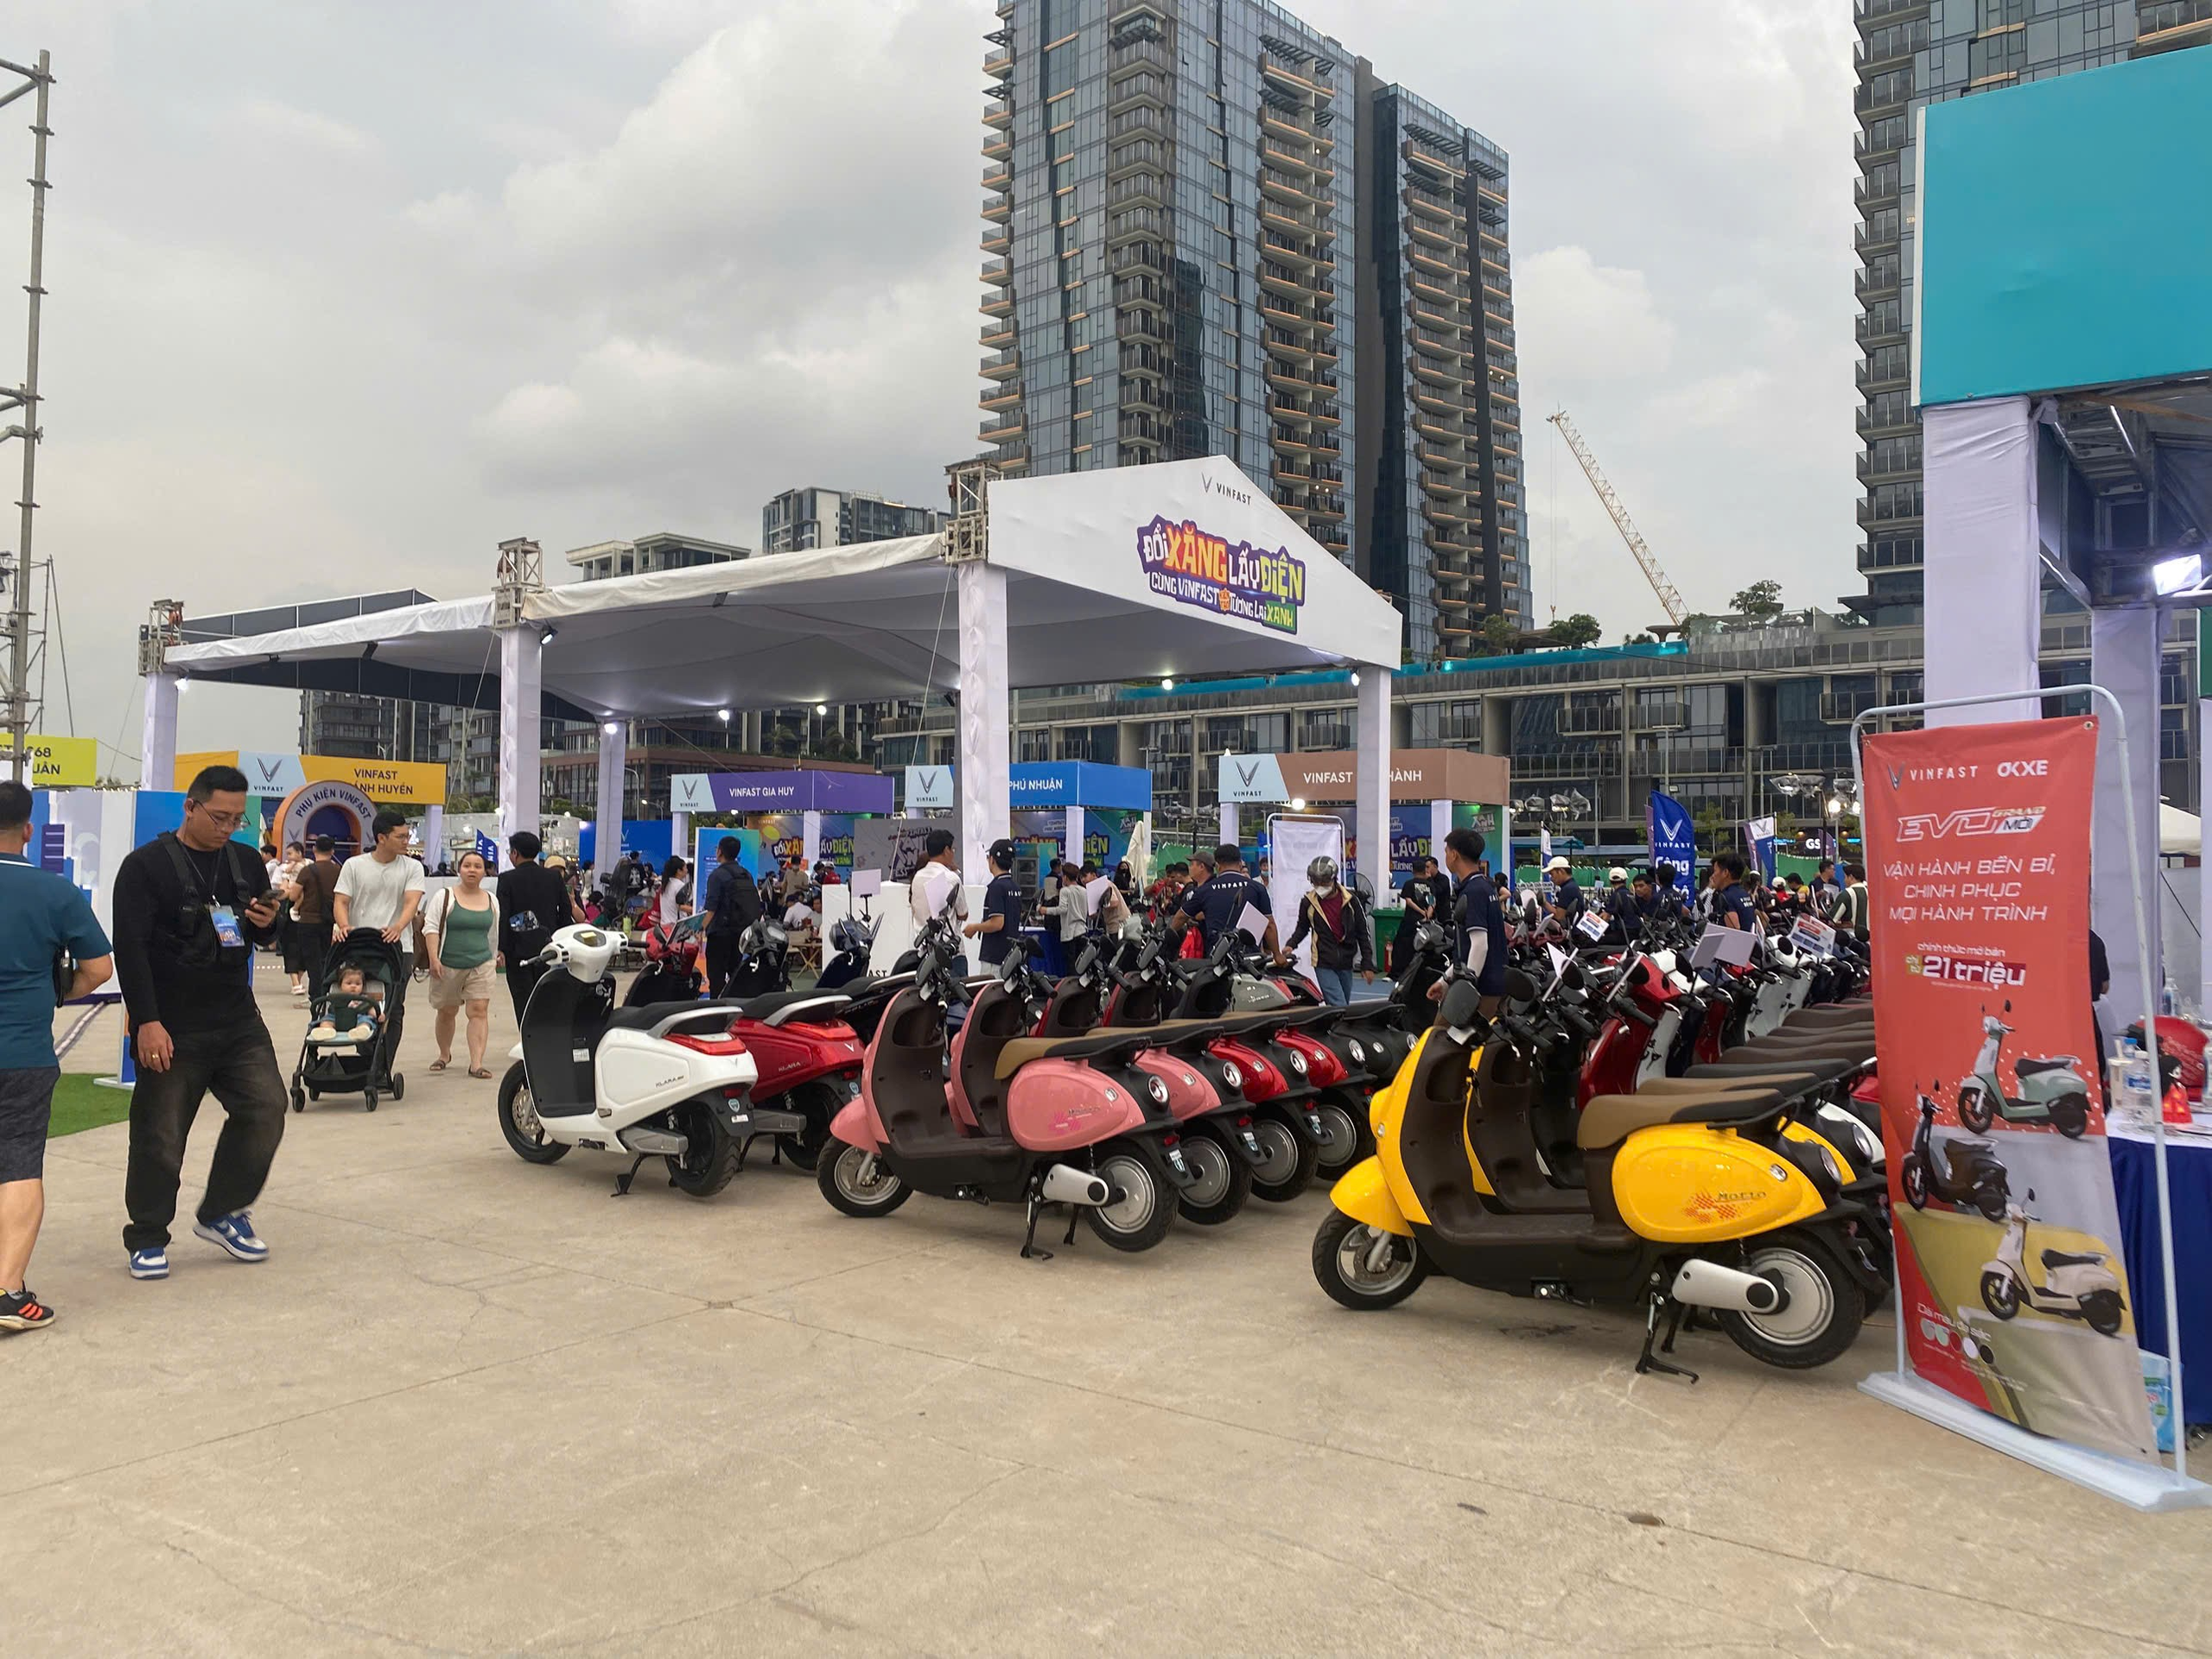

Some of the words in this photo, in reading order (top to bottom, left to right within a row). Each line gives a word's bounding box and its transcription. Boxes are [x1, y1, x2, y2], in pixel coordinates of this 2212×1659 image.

[1216, 482, 1251, 505] VINFAST
[1166, 524, 1227, 582] XĂNG
[1229, 548, 1260, 588] LẤY
[1152, 571, 1177, 594] CÙNG
[1230, 592, 1253, 618] TƯƠNG
[1266, 605, 1294, 627] XANH
[354, 768, 397, 780] VINFAST
[1303, 772, 1354, 784] VINFAST
[1910, 766, 1979, 780] VINFAST
[1997, 760, 2049, 777] OKXE
[729, 787, 761, 797] VINFAST
[762, 787, 777, 796] GIA
[778, 786, 795, 796] HUY
[1028, 779, 1063, 792] NHUẬN
[296, 798, 314, 818] PHỤ
[313, 787, 336, 802] KIỆN
[339, 789, 372, 819] VINFAST
[1883, 861, 1915, 880] VẬN
[1918, 859, 1972, 876] HÀNH
[1977, 855, 2024, 874] BỀN
[1211, 881, 1248, 890] VINFAST
[1961, 882, 2023, 901] PHỤC
[1889, 906, 1916, 924] MỌI
[1921, 903, 1974, 921] HÀNH
[1981, 903, 2049, 921] TRÌNH
[1922, 955, 1951, 980] 21
[1954, 960, 2026, 990] triệu
